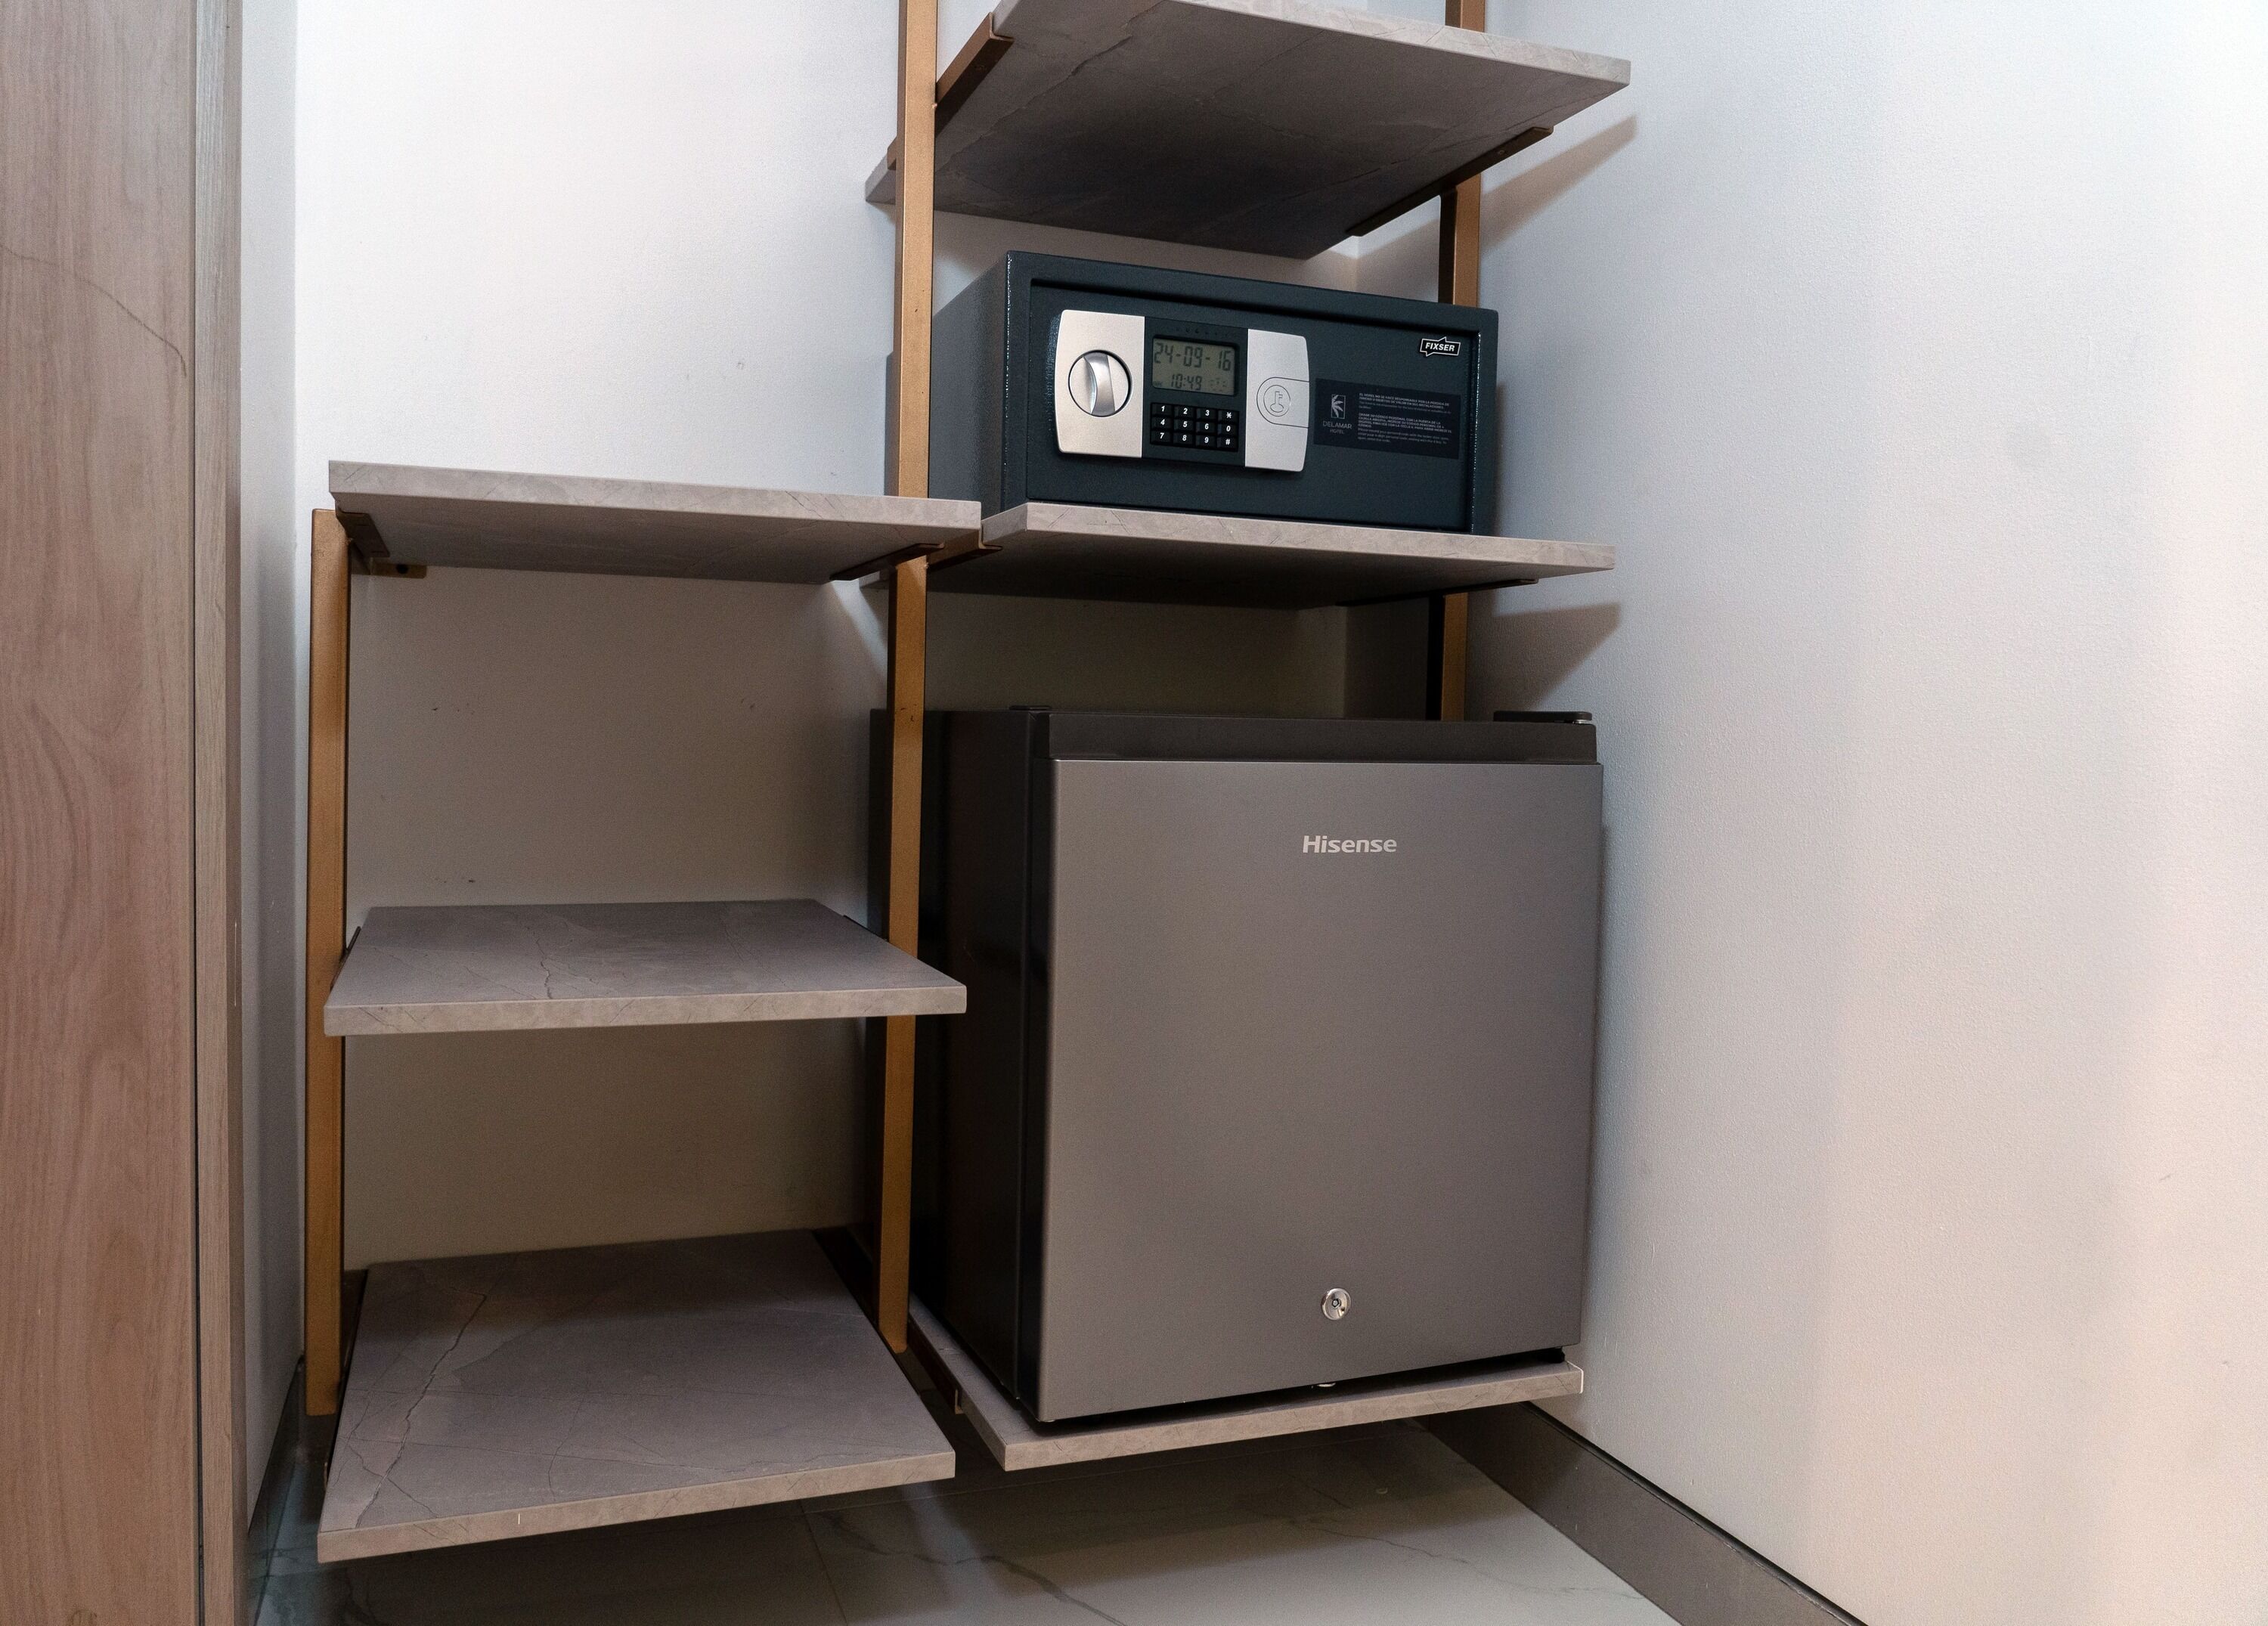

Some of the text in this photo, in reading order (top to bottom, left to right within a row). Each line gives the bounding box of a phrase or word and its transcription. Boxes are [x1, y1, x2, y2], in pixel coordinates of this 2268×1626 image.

[1425, 342, 1455, 352] FIXSER
[1323, 421, 1352, 429] DELAMAR
[1303, 835, 1397, 853] Hisense
